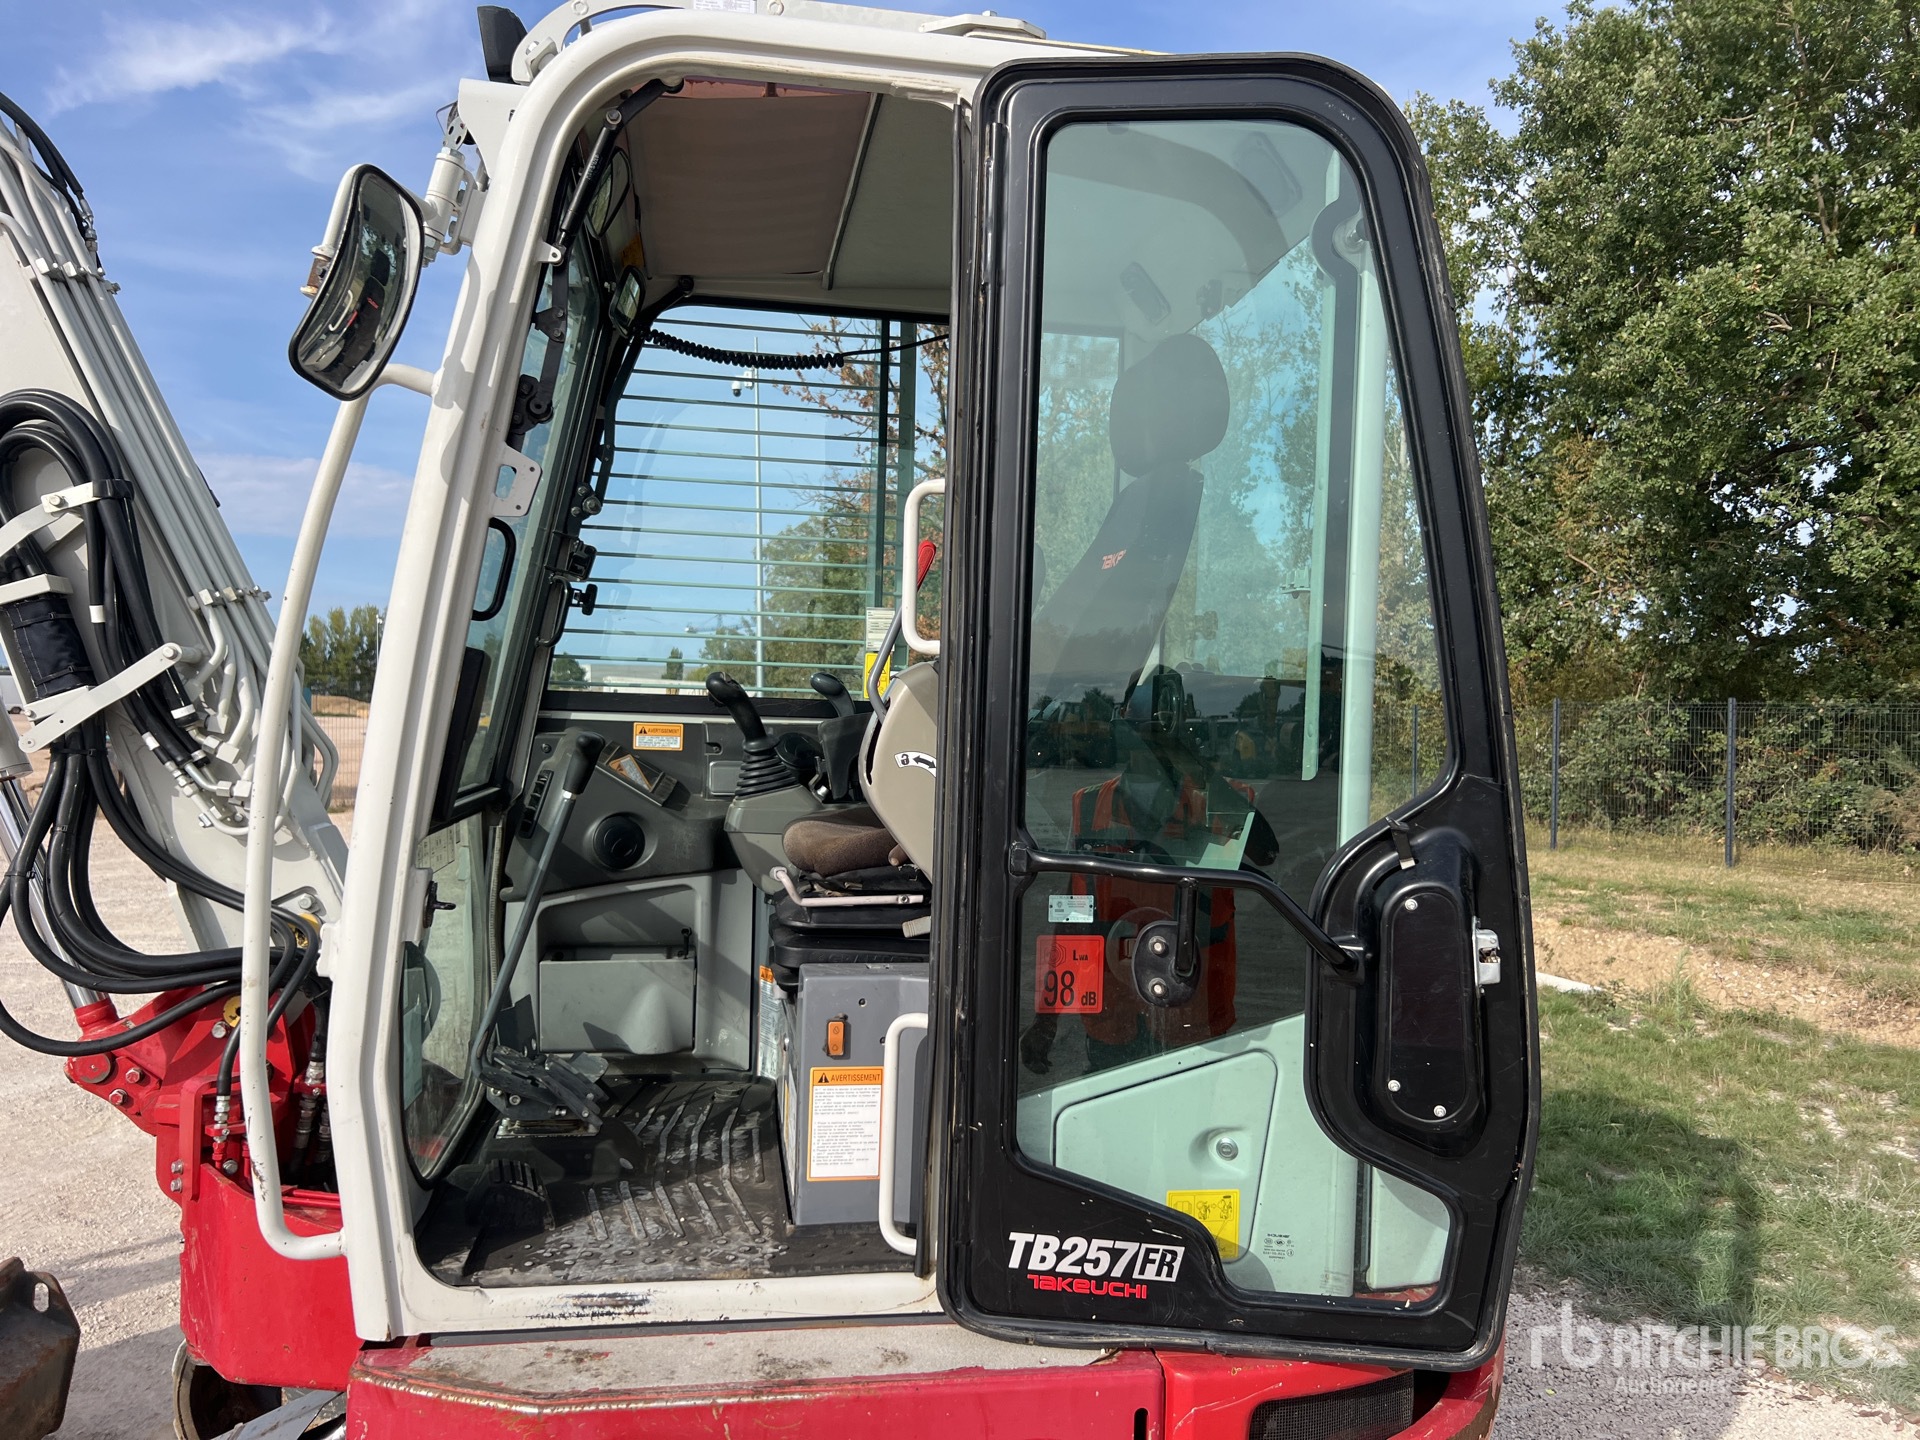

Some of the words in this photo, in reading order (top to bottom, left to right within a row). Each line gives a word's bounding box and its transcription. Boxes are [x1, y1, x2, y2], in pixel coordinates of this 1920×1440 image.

[1043, 970, 1075, 1007] 98
[1081, 991, 1097, 1006] dB
[830, 1073, 881, 1082] AVERTISSEMENT
[1027, 1274, 1148, 1299] TAKEUCHI
